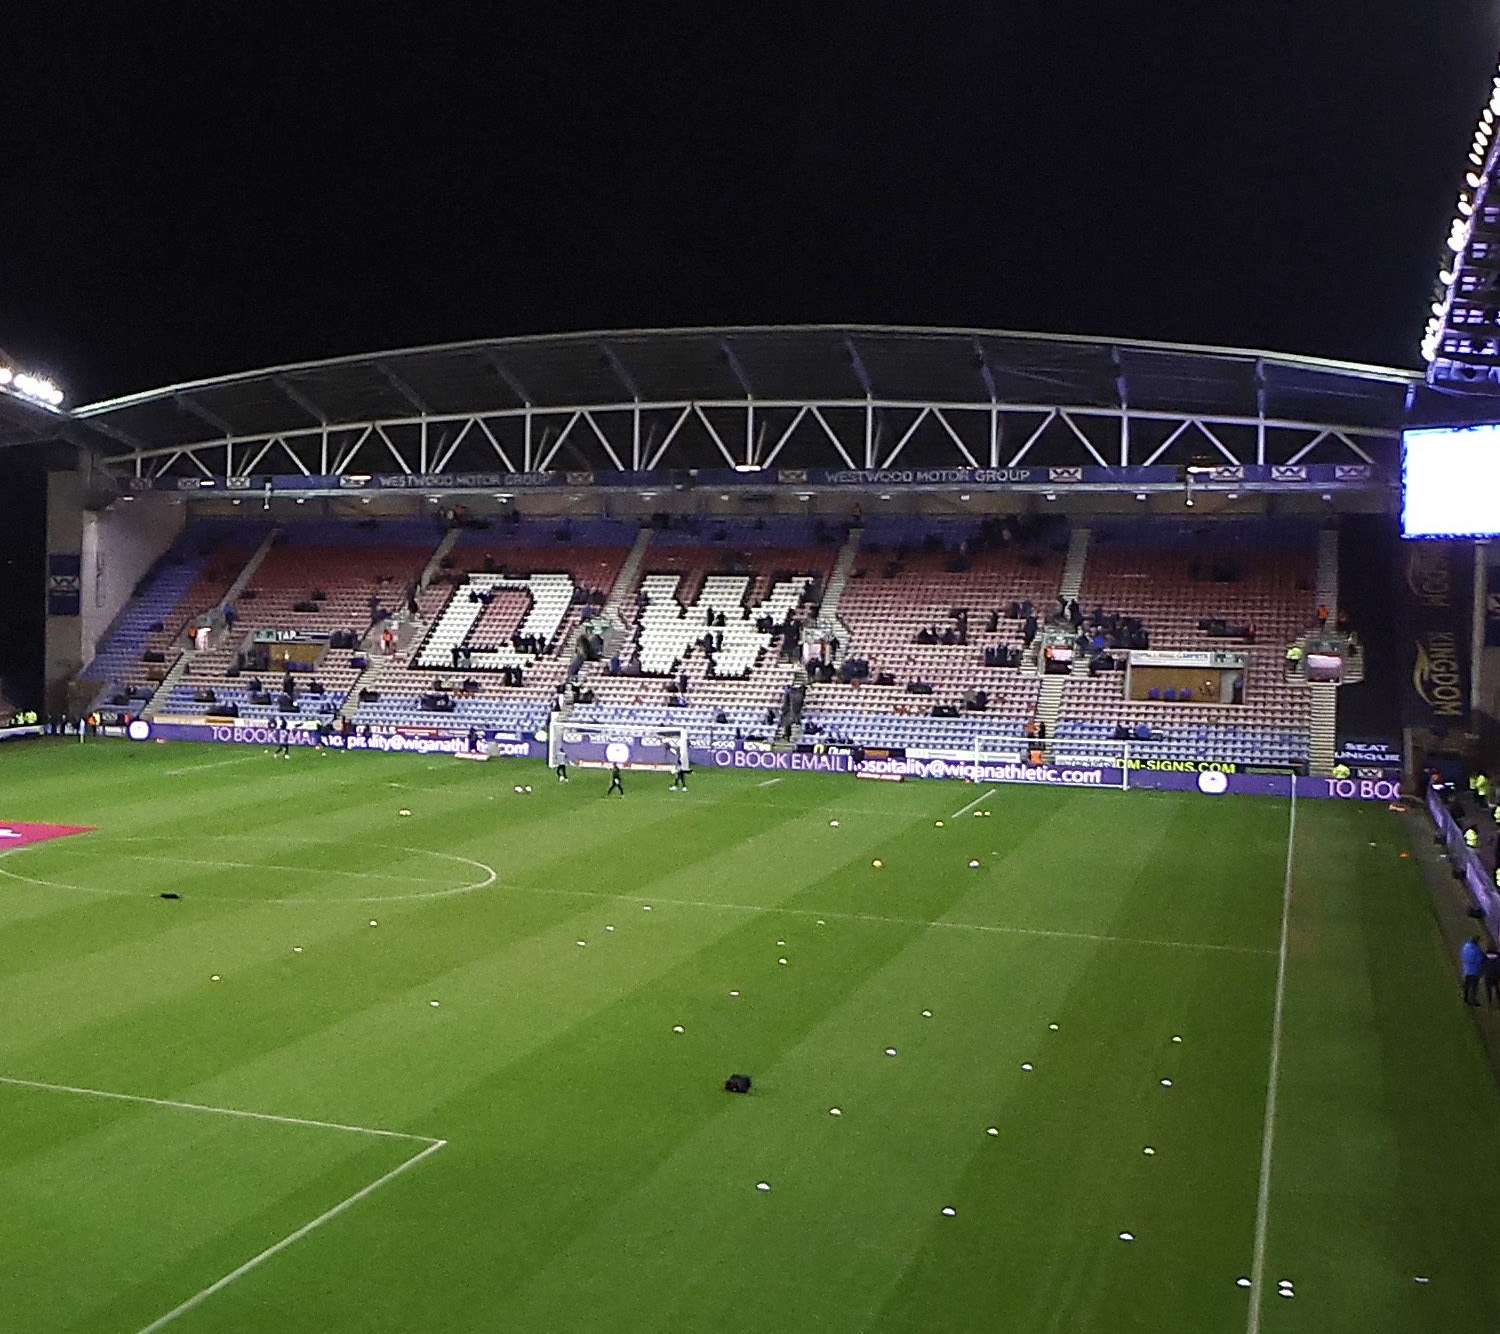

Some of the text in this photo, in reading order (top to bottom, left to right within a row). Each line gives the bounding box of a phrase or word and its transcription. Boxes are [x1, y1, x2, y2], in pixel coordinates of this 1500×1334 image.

[380, 476, 452, 488] WESTWOOD
[826, 469, 1030, 483] WESTWOOD MOTOR GROUP
[212, 726, 231, 742] TO
[234, 727, 277, 743] BOOK
[1345, 742, 1388, 752] SEAT
[711, 750, 731, 766] TO
[735, 751, 788, 769] BOOK
[792, 753, 845, 771] EMAIL
[1116, 758, 1236, 774] DM-SIGNS.COM
[1326, 779, 1354, 797] TO
